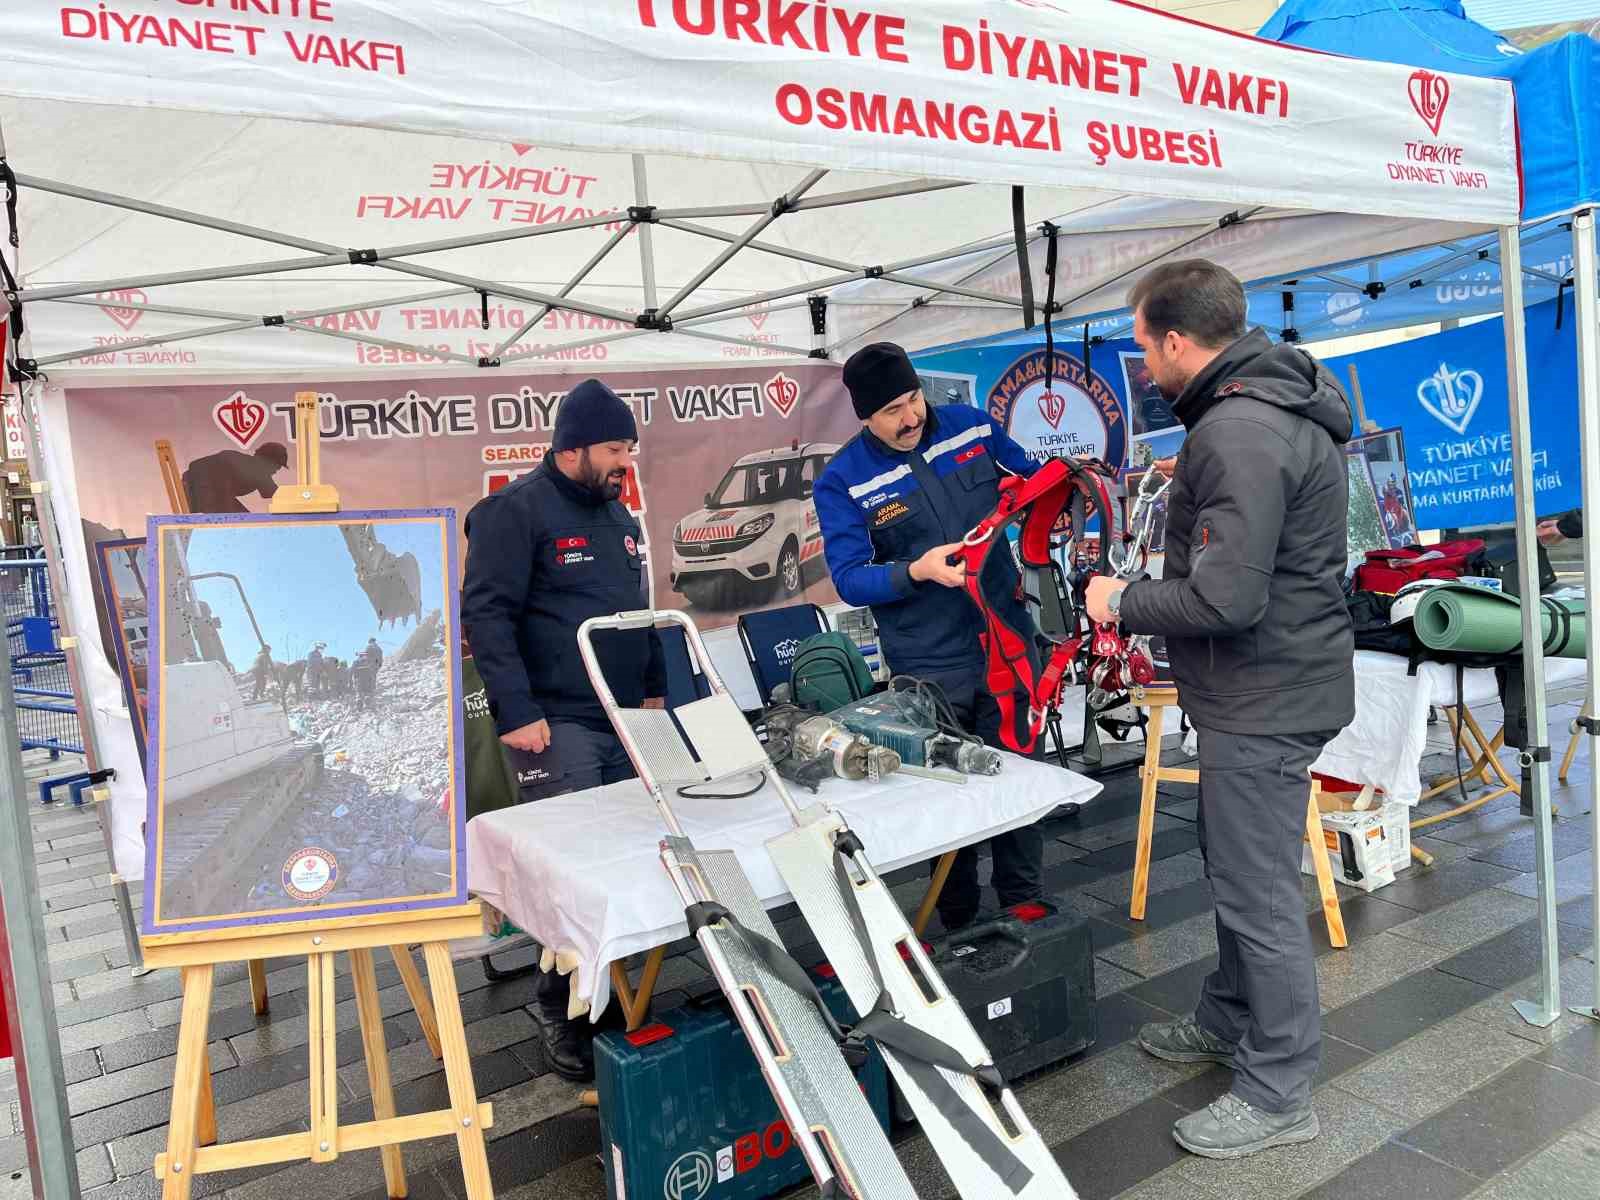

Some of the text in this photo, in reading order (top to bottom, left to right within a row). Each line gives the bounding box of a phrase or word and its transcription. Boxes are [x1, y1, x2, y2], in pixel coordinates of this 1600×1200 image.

[61, 3, 405, 75] DİYANET VAKFI
[942, 19, 1148, 97] DİYANET
[1173, 63, 1289, 118] VAKFI
[775, 83, 1223, 168] OSMANGAZİ ŞUBESİ
[1405, 139, 1464, 166] TÜRKİYE
[1387, 161, 1488, 189] DİYANET VAKFI
[668, 386, 762, 419] VAKFI
[1425, 433, 1512, 464] TÜRKİYE
[1443, 482, 1514, 505] KURTARM
